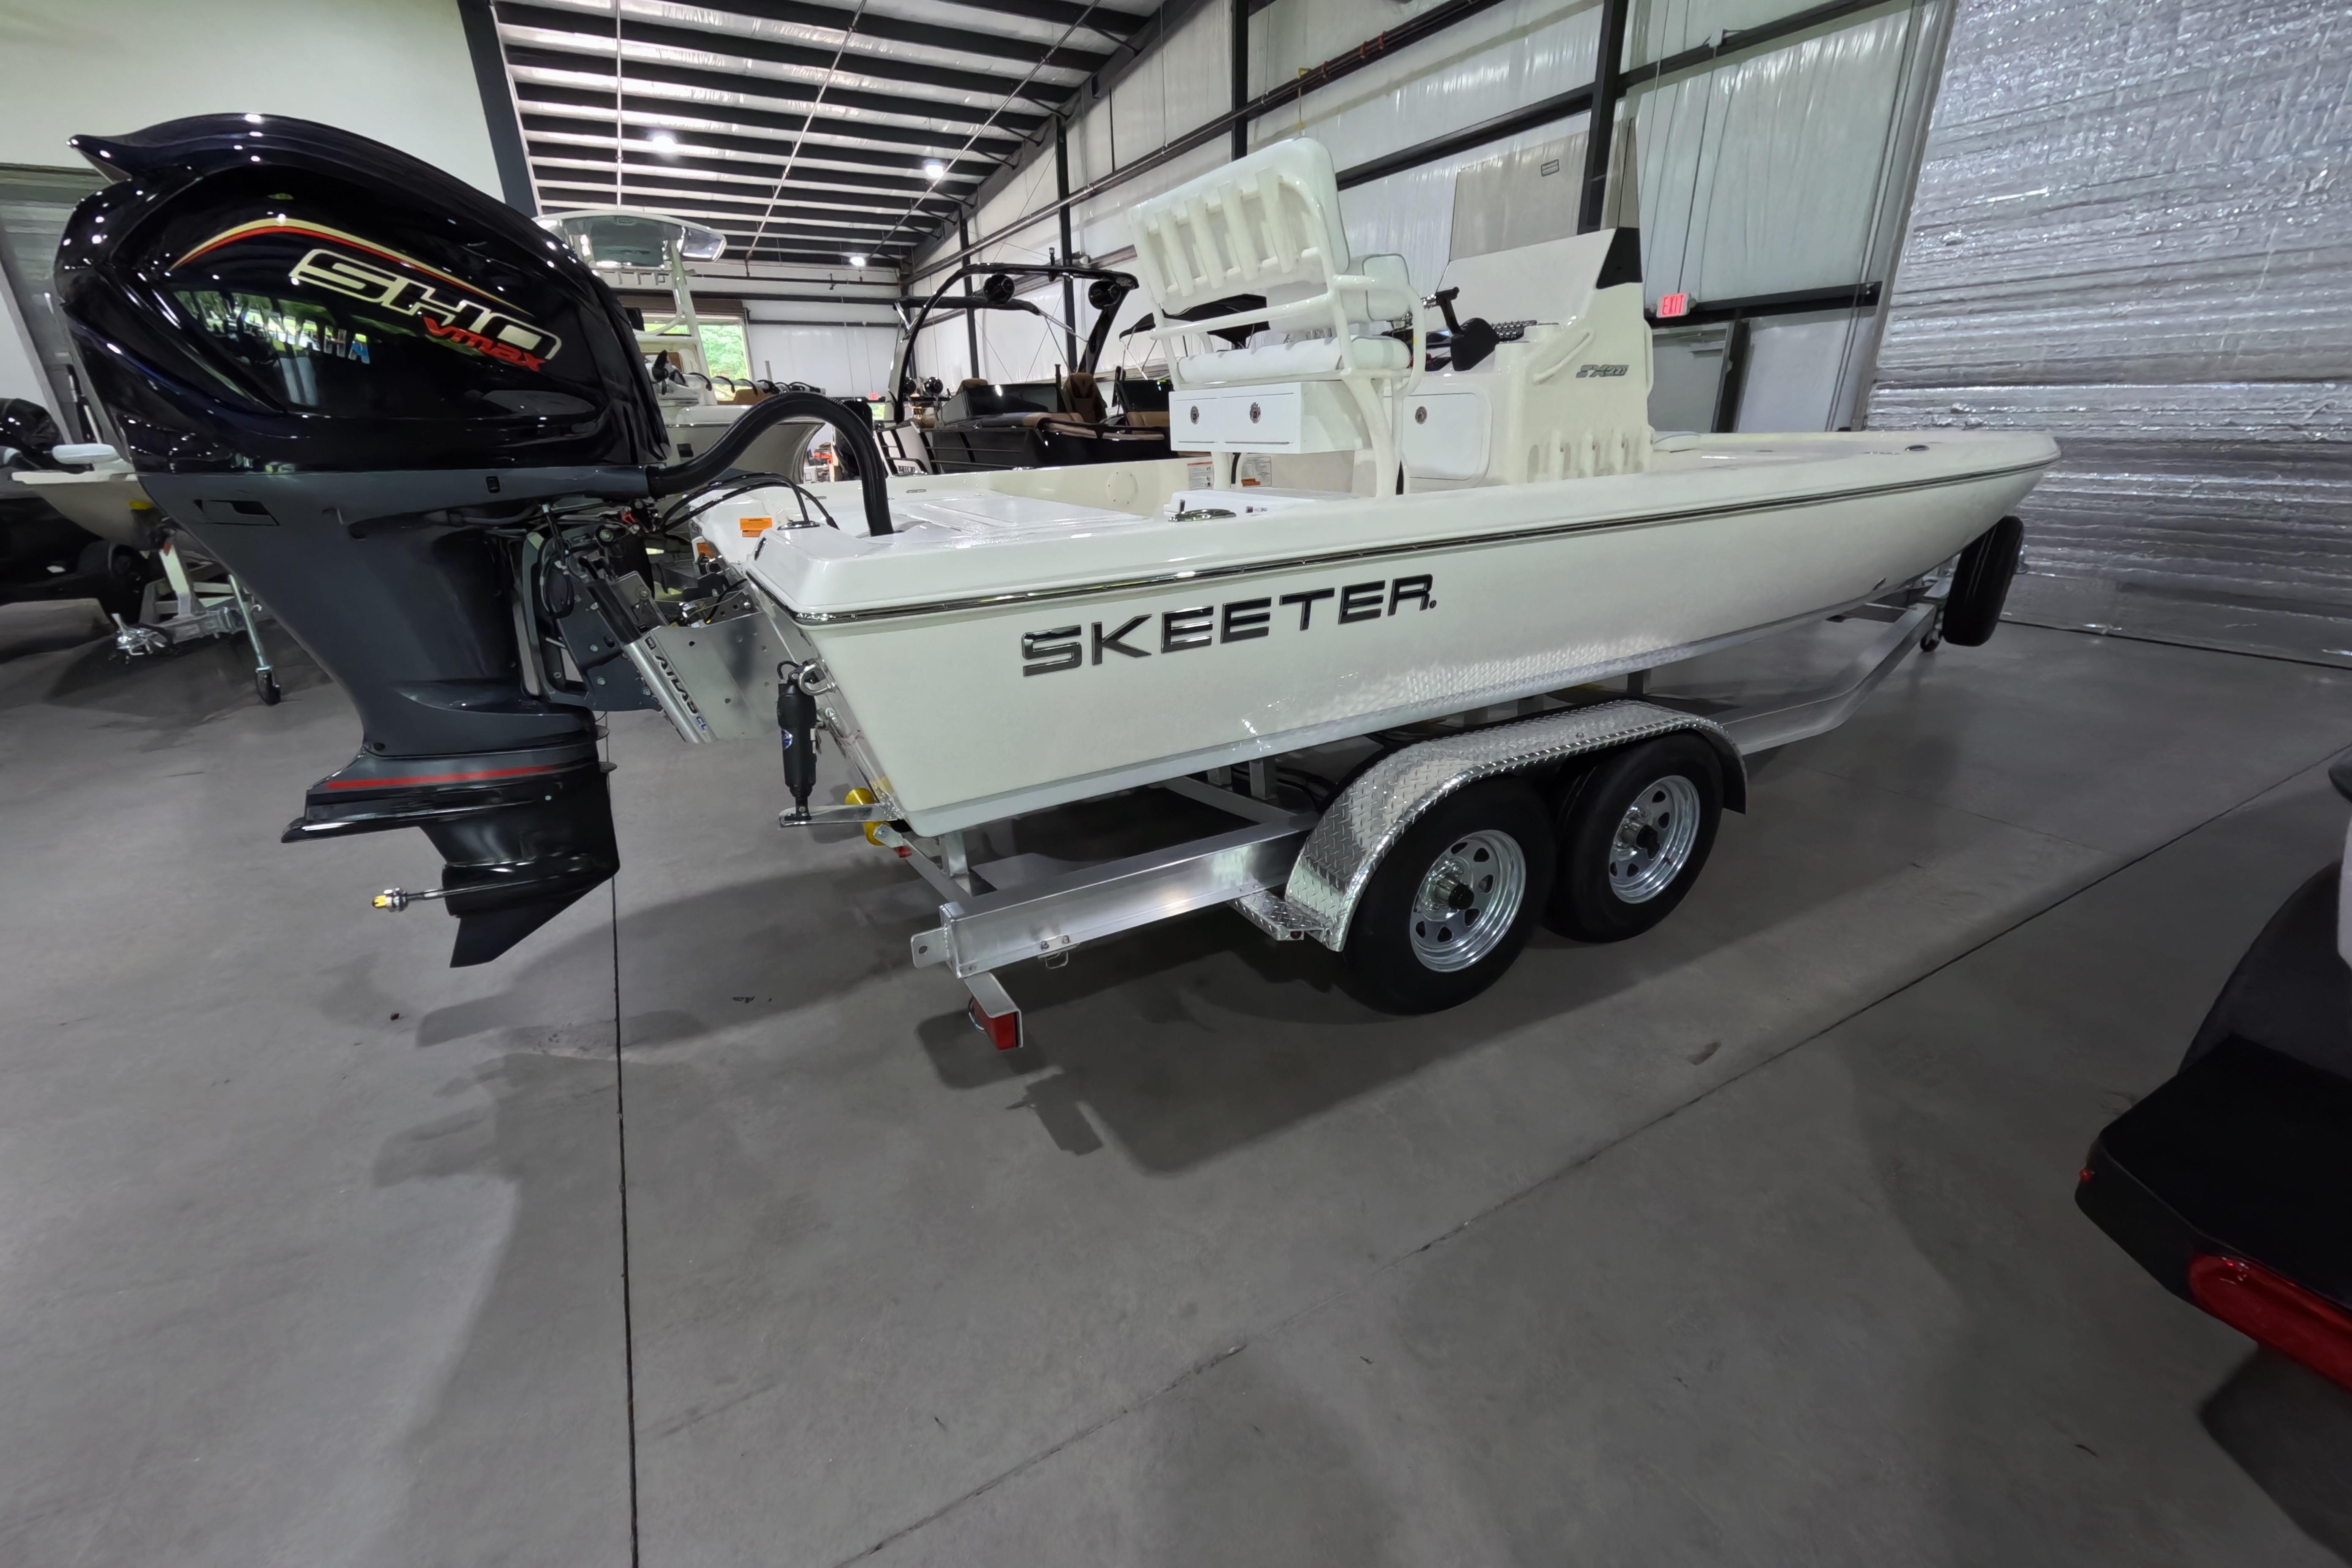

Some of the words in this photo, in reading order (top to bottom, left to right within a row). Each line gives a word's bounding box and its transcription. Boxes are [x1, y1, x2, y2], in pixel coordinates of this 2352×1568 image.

[289, 248, 561, 359] SHO
[1662, 295, 1684, 316] EXIT
[1021, 573, 1435, 677] SKEETER
